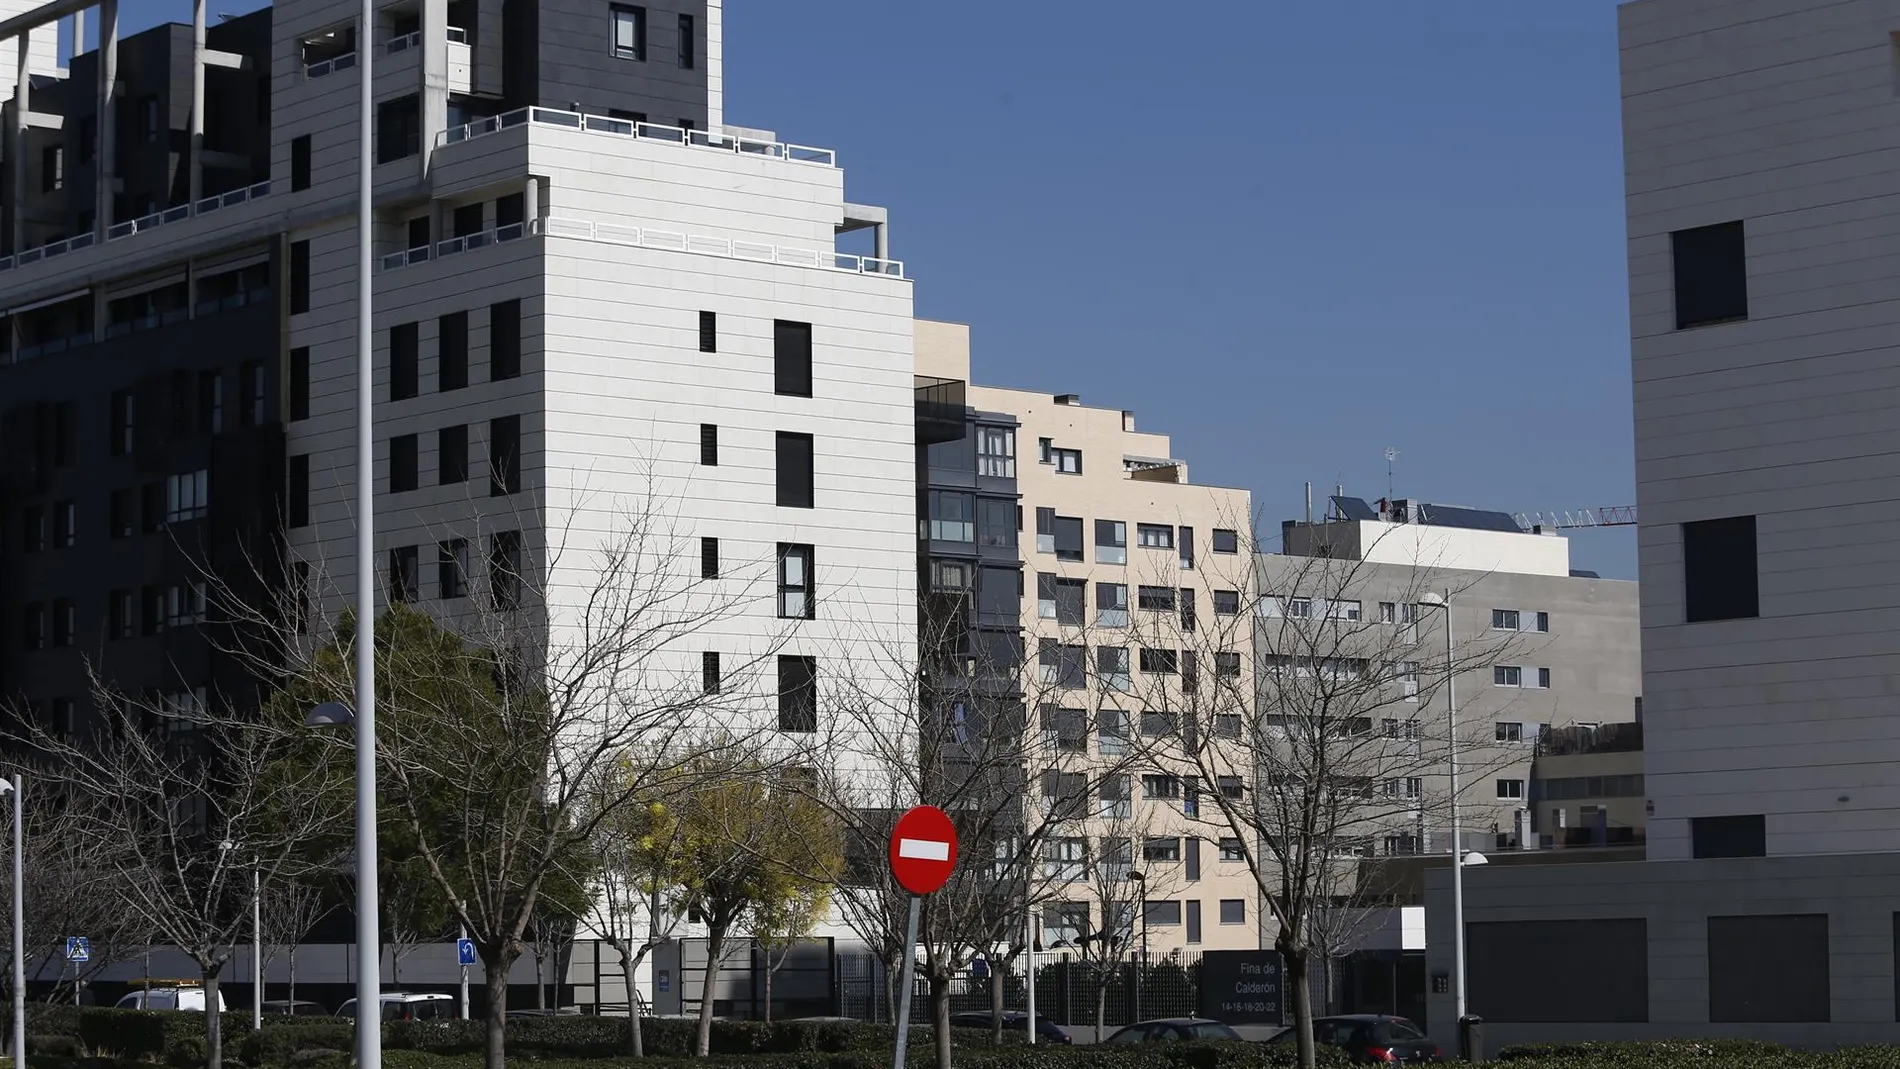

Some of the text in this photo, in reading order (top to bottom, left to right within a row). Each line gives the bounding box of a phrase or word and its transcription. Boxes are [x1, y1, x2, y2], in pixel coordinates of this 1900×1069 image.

[1240, 962, 1275, 974] Fina de
[1235, 981, 1275, 993] Calderón
[1221, 1002, 1276, 1011] 14-16-18-20-22
